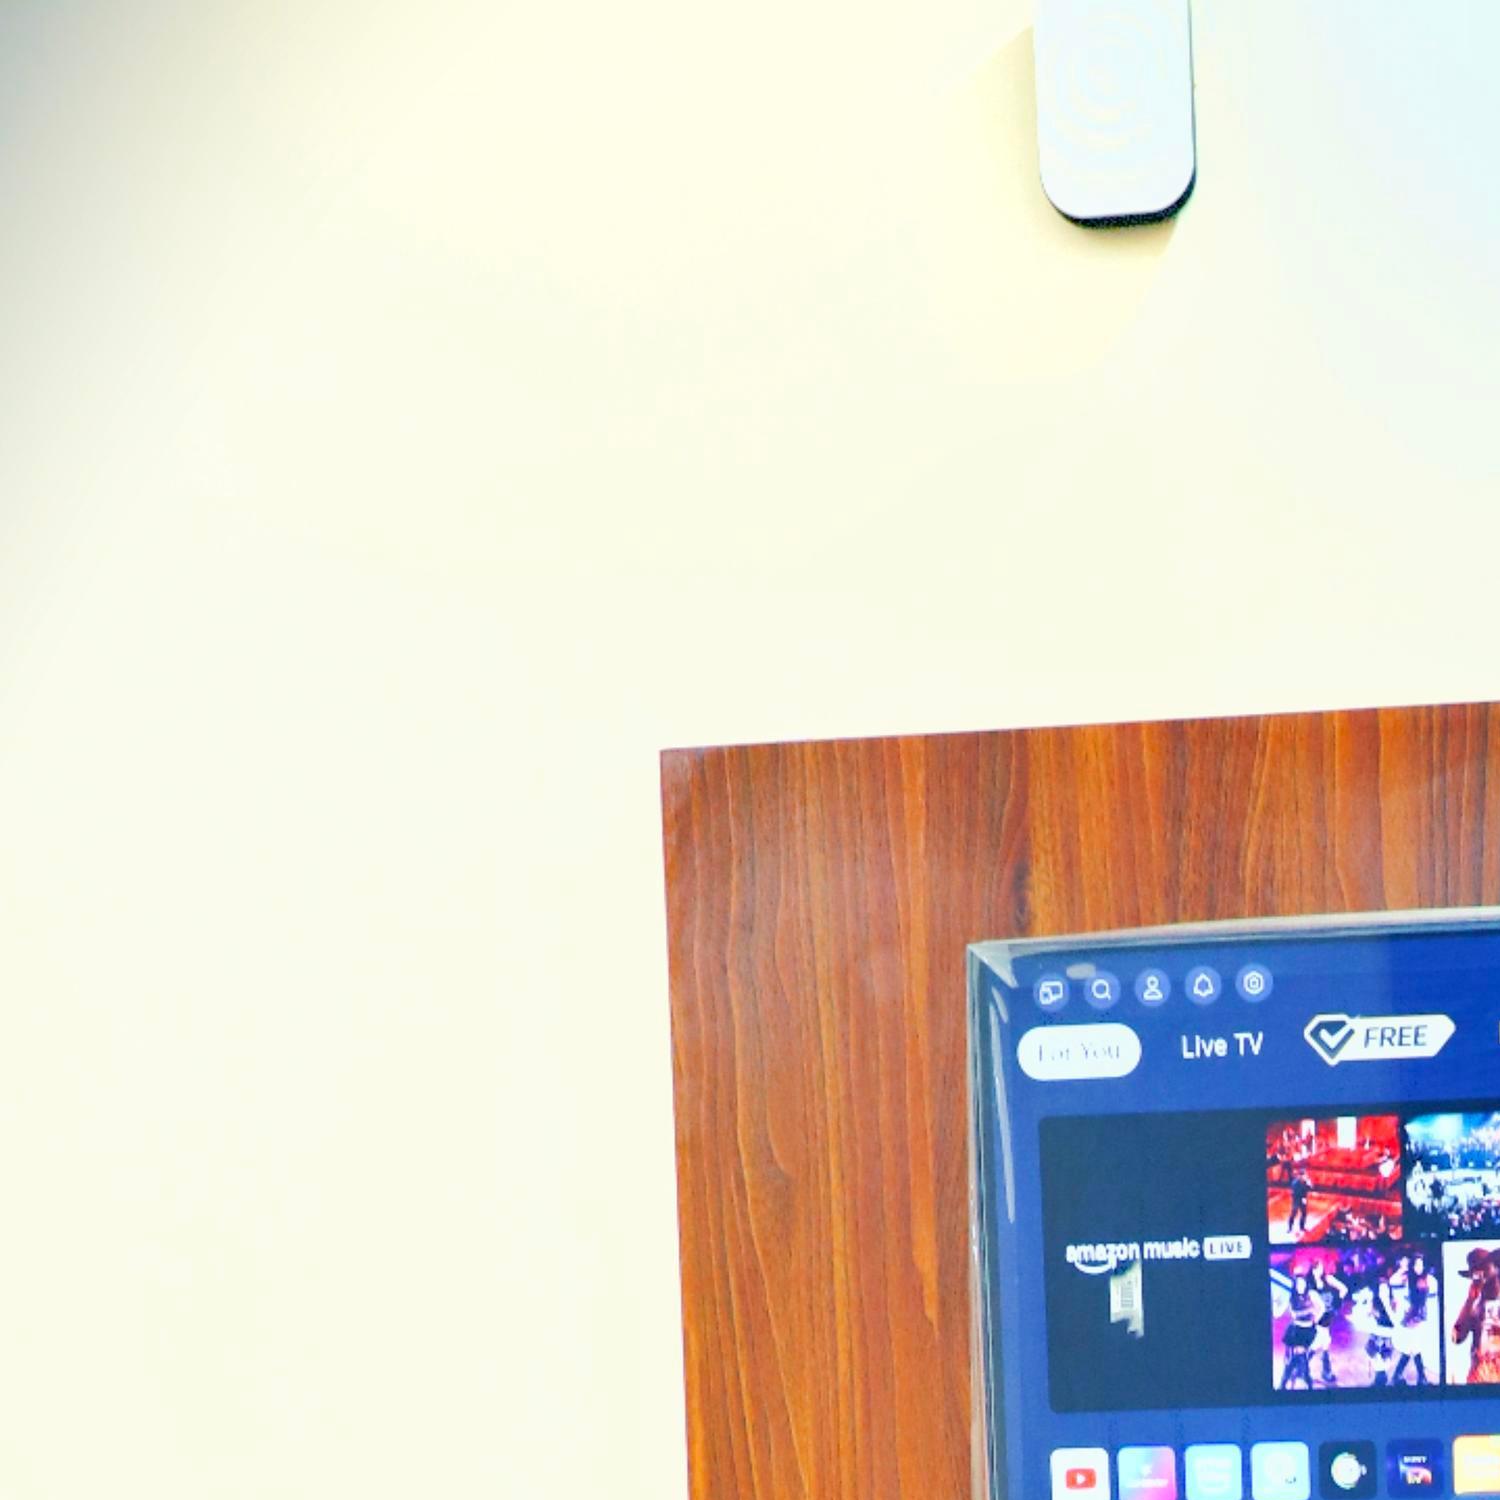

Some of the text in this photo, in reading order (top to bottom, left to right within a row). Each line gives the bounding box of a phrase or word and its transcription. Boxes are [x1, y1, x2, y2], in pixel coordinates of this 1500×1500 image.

[1181, 1031, 1264, 1060] Live TV
[1363, 1024, 1428, 1049] FREE
[1065, 1236, 1244, 1266] amazon music LIVE
